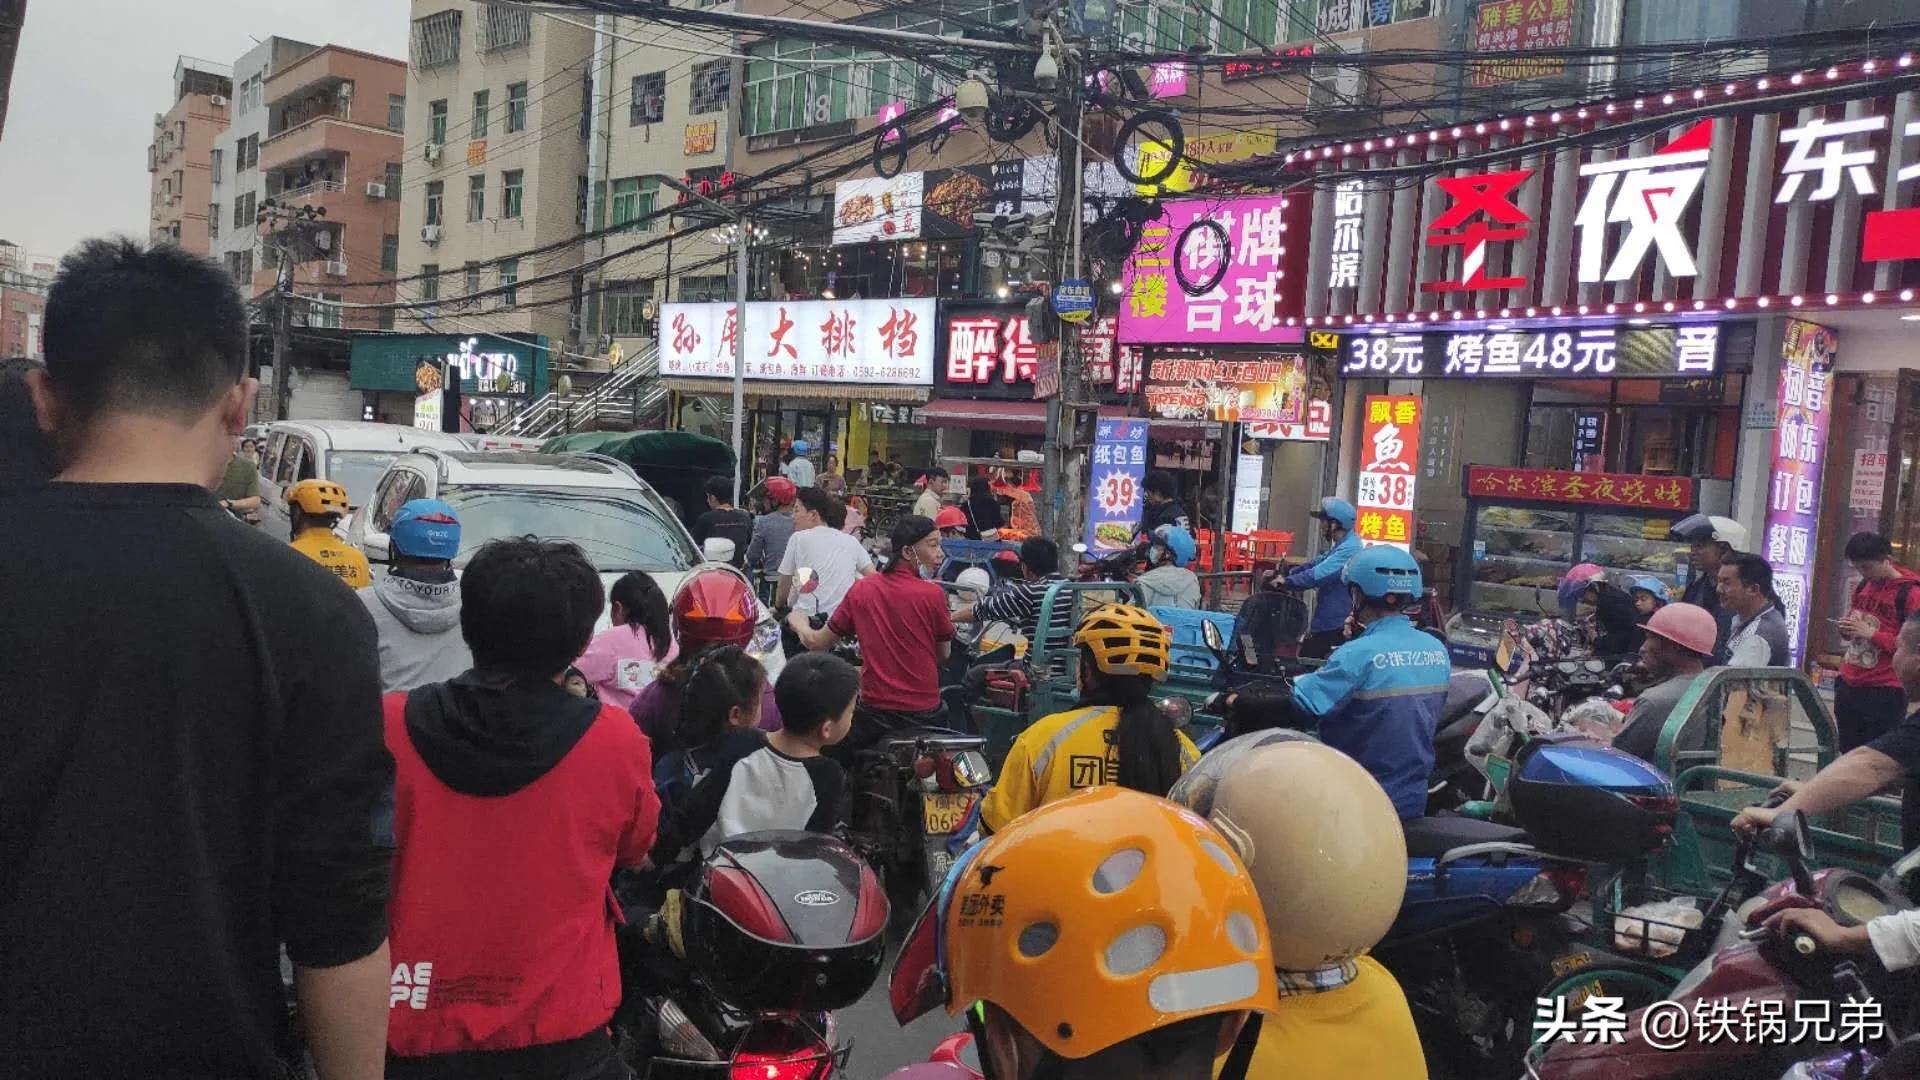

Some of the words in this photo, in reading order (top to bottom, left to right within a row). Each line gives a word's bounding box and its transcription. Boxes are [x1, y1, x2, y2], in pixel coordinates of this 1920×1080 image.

[1329, 180, 1364, 288] 哈尔滨
[1184, 272, 1280, 333] 台球
[1445, 329, 1616, 374] 烤鱼48元
[1675, 326, 1719, 372] 音
[1370, 400, 1417, 424] 飘香
[1095, 445, 1144, 465] 纸包鱼
[1106, 478, 1133, 507] 39
[1378, 475, 1407, 506] 38
[1476, 472, 1682, 508] 哈尔滨圣夜烧烤
[1360, 511, 1406, 541] 烤鱼
